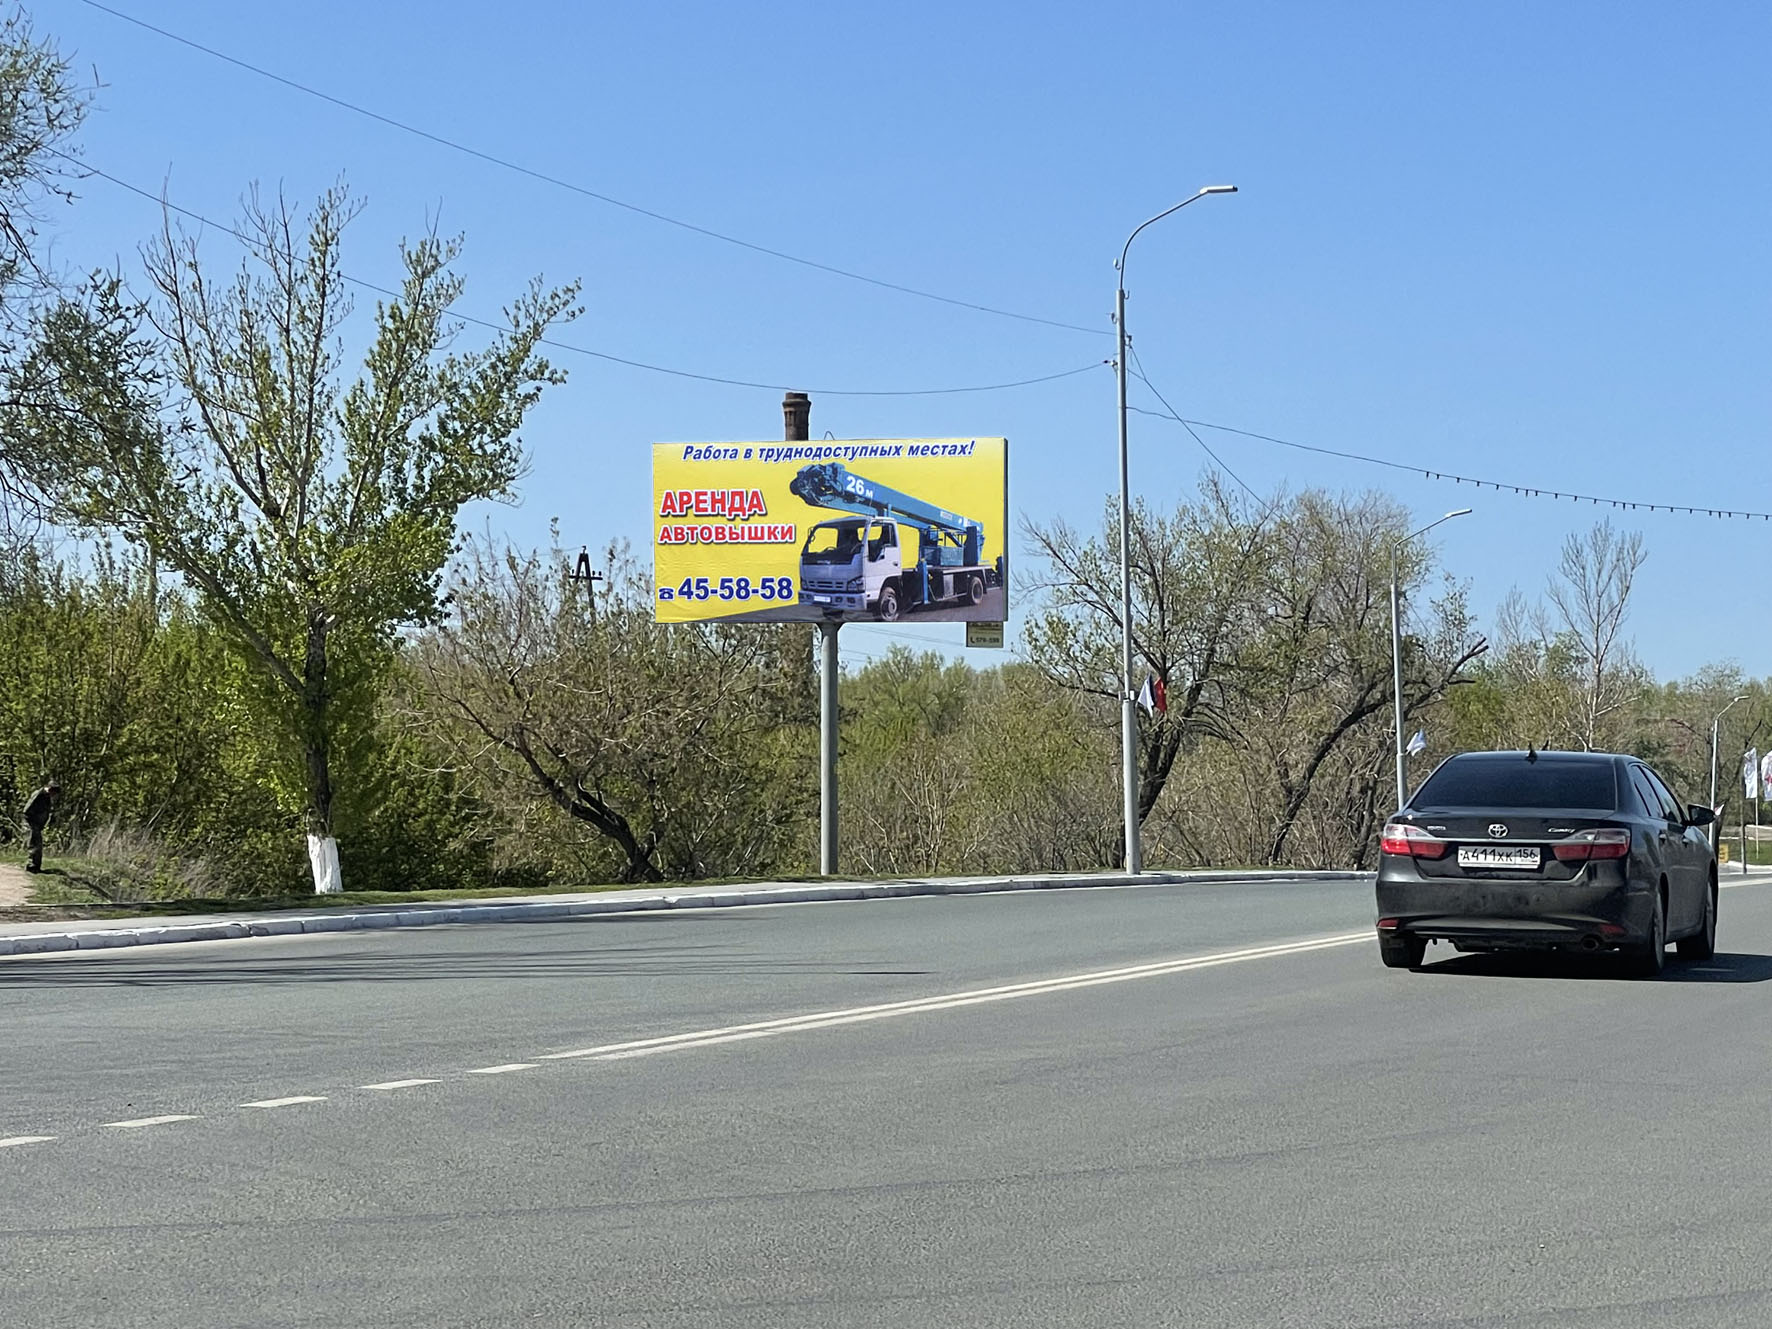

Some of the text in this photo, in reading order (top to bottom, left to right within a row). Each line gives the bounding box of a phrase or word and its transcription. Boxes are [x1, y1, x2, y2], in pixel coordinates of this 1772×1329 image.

[683, 440, 975, 462] Работа в труднодоступных местах!
[846, 475, 865, 495] 26
[661, 490, 766, 517] АРЕНДА
[659, 525, 794, 542] АВТОВЫШКИ
[678, 577, 793, 600] 45-58-58
[1516, 848, 1537, 859] 156
